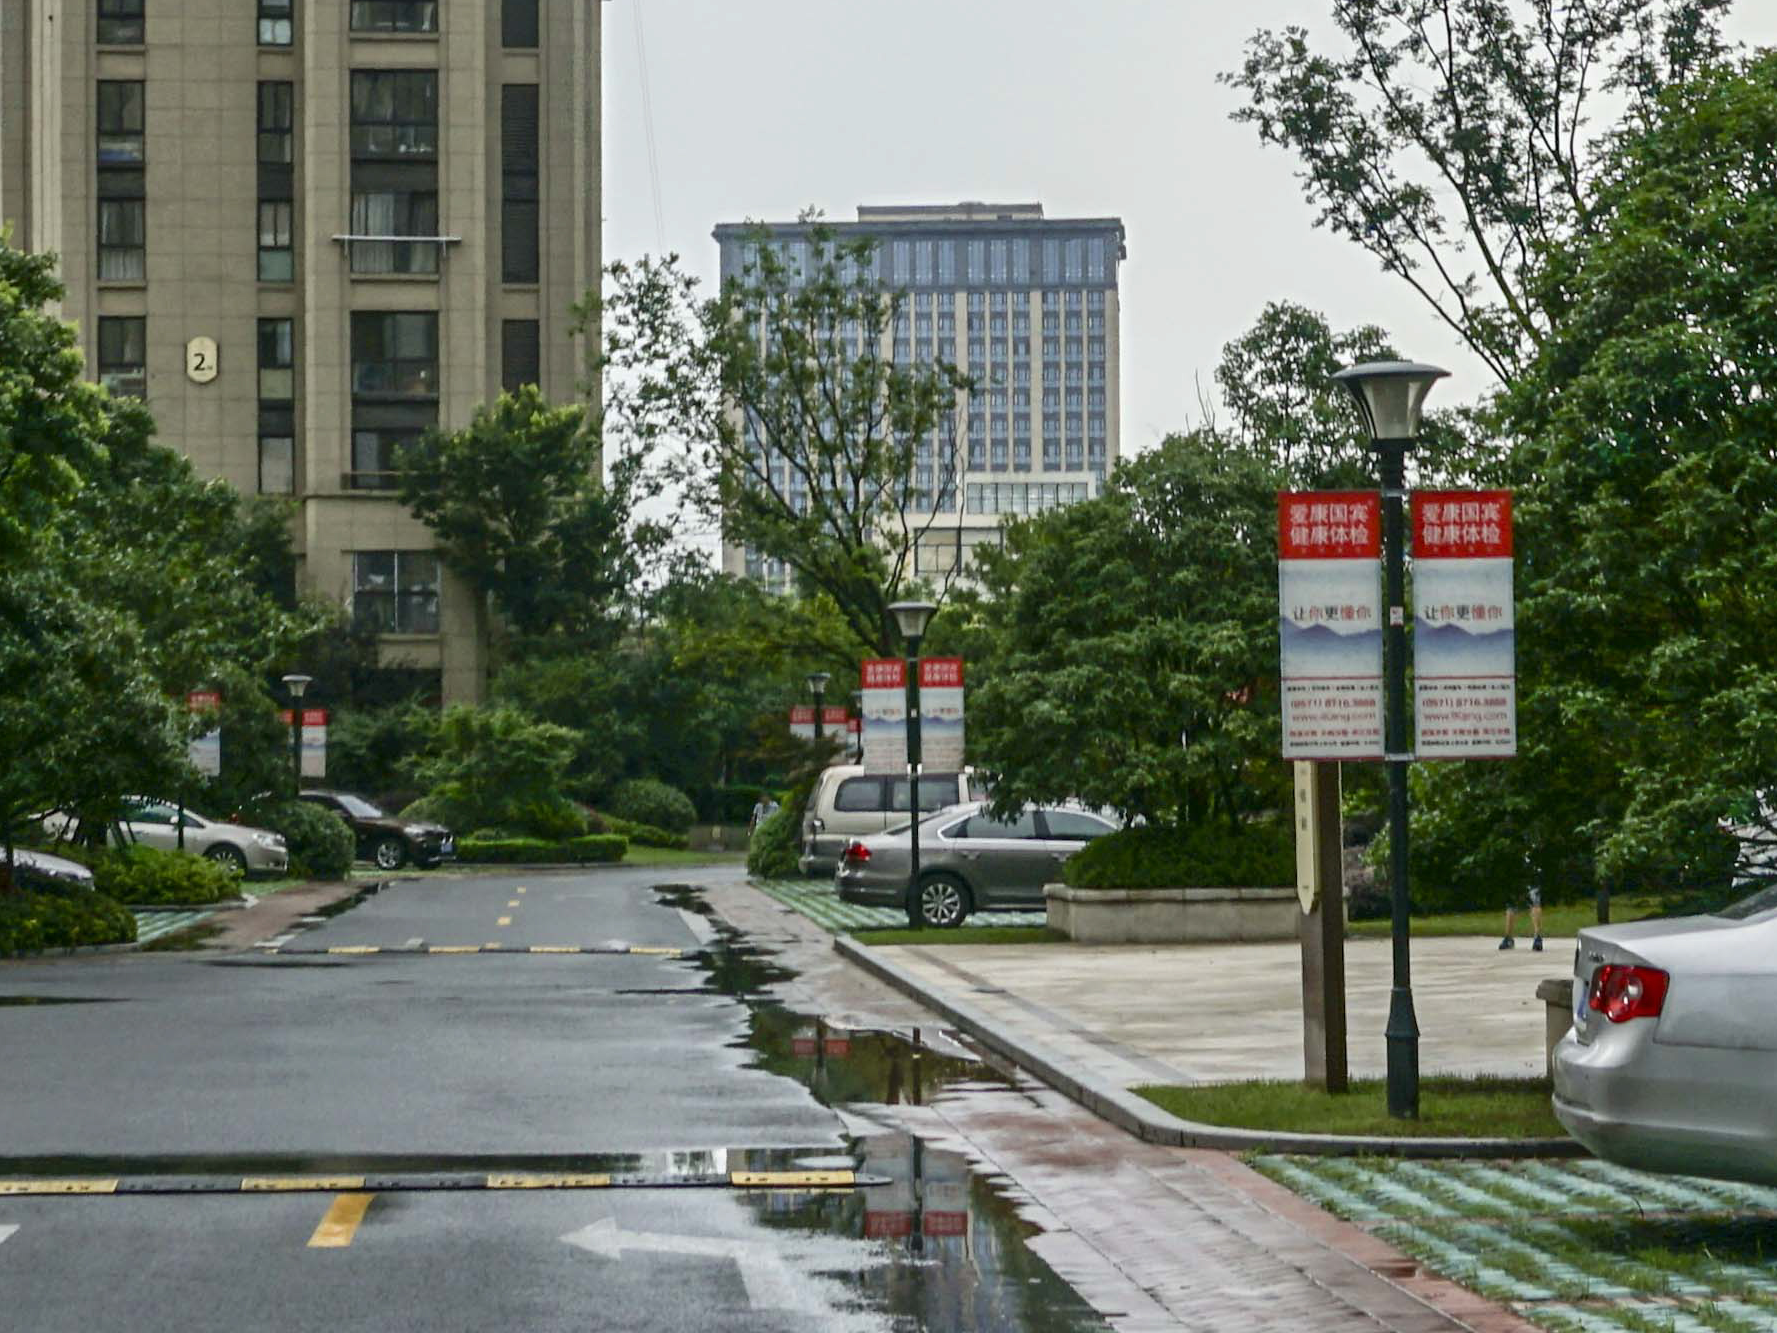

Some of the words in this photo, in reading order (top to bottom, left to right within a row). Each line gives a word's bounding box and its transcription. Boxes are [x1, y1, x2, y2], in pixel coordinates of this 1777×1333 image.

[1289, 524, 1369, 547] 健康体检
[1421, 523, 1502, 545] 健康体检
[1293, 605, 1373, 622] 让你更懂你
[1424, 605, 1503, 622] 让你更懂你
